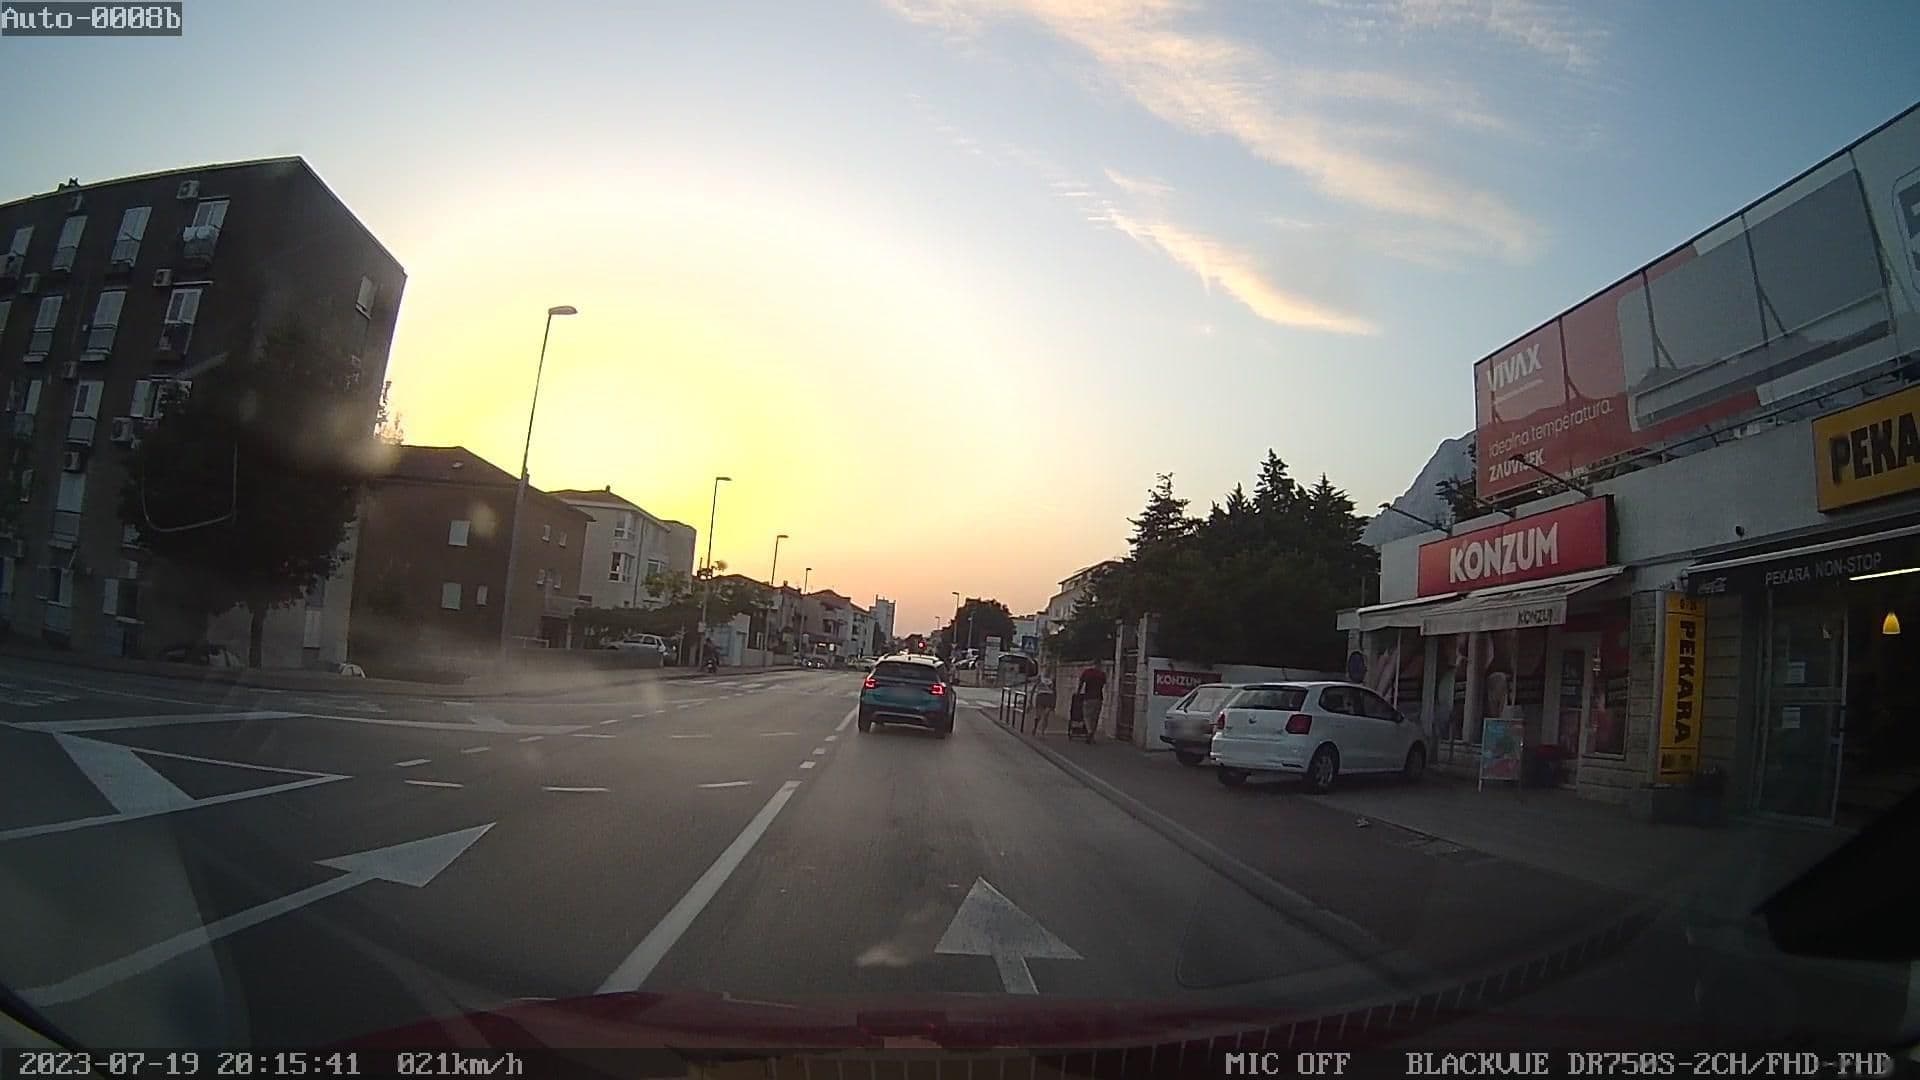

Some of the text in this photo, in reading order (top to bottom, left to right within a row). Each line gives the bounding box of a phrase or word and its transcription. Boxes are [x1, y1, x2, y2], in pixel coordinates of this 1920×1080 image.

[1487, 344, 1542, 392] VIVAX
[1488, 430, 1530, 458] idealno
[1450, 522, 1558, 583] KONZUM
[1764, 552, 1882, 585] PEKARA NON-STOP
[1674, 620, 1696, 744] PEKARA
